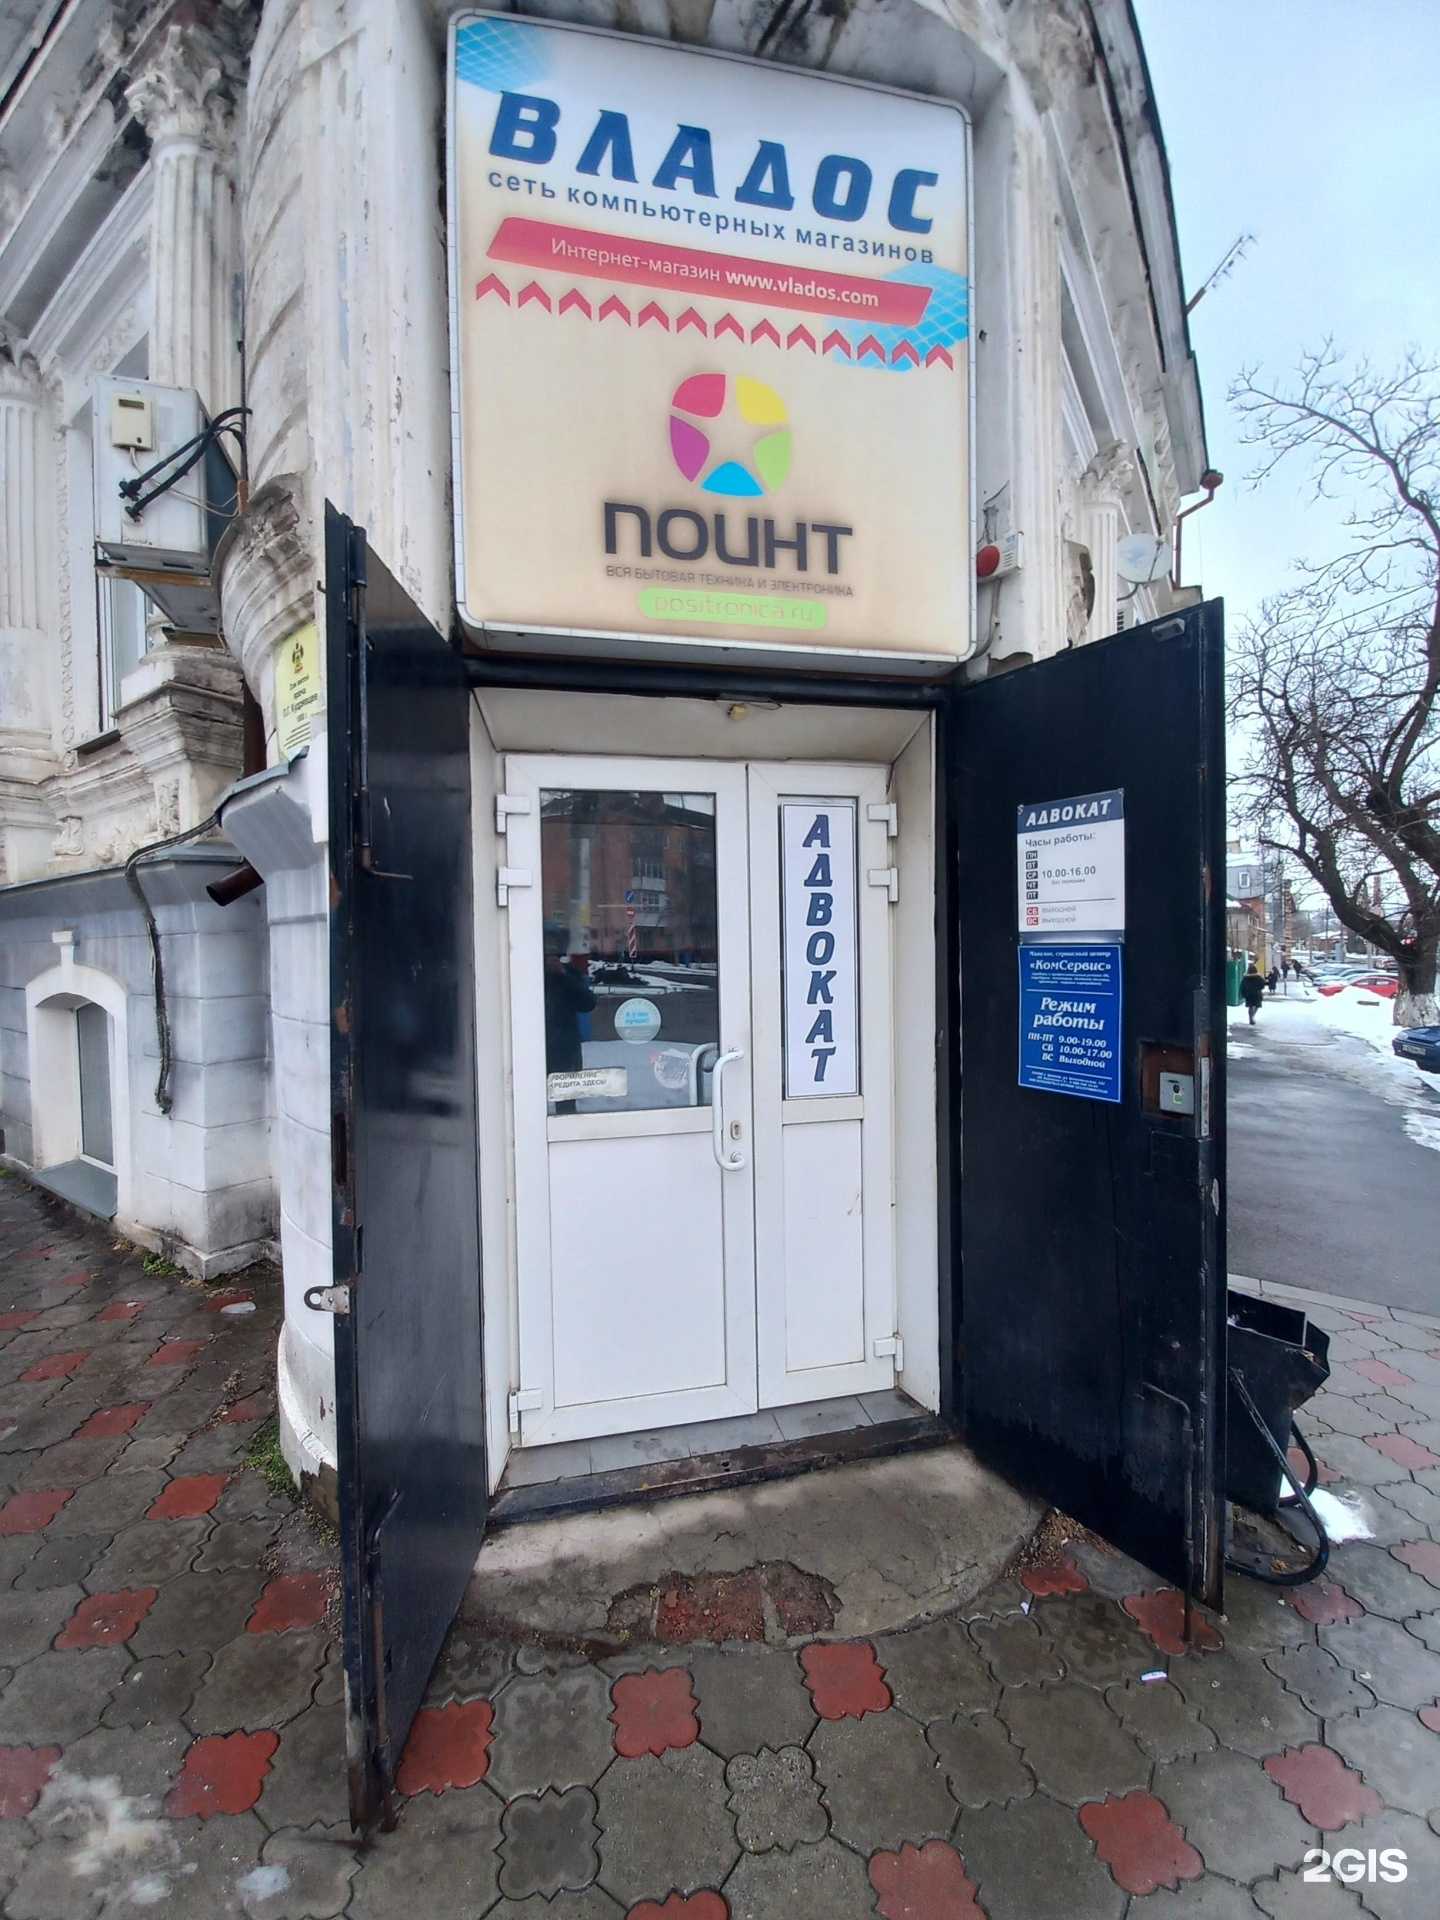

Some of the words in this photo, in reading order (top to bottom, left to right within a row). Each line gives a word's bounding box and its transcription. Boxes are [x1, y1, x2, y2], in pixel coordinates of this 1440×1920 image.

[489, 91, 939, 235] ВЛАДОС
[488, 170, 557, 200] сеть
[567, 187, 786, 242] компьютерных
[796, 226, 934, 264] магазинов
[551, 237, 721, 282] Интернет-магазин
[726, 271, 880, 307] www.vlados.com
[606, 565, 631, 578] ВСЯ
[634, 567, 695, 584] БЫТОВАЯ
[699, 573, 754, 589] ТЕХНИКА
[757, 578, 767, 589] И
[770, 580, 854, 598] ЭЛЕКТРОНИКА
[1026, 799, 1112, 827] АДВОКАТ
[1025, 839, 1051, 848] Часы
[1042, 866, 1096, 879] 10.00-16.00
[802, 814, 837, 1082] АДВОКАТ
[1030, 959, 1111, 972] «КомСервис»
[1040, 997, 1097, 1014] Режим
[1033, 1012, 1105, 1031] работы
[1058, 1035, 1107, 1048] 9.00-19.00
[1042, 1043, 1053, 1051] СБ
[1059, 1046, 1112, 1059] 10.00-17.00
[1042, 1053, 1053, 1061] ВС
[1059, 1055, 1106, 1068] Выходной
